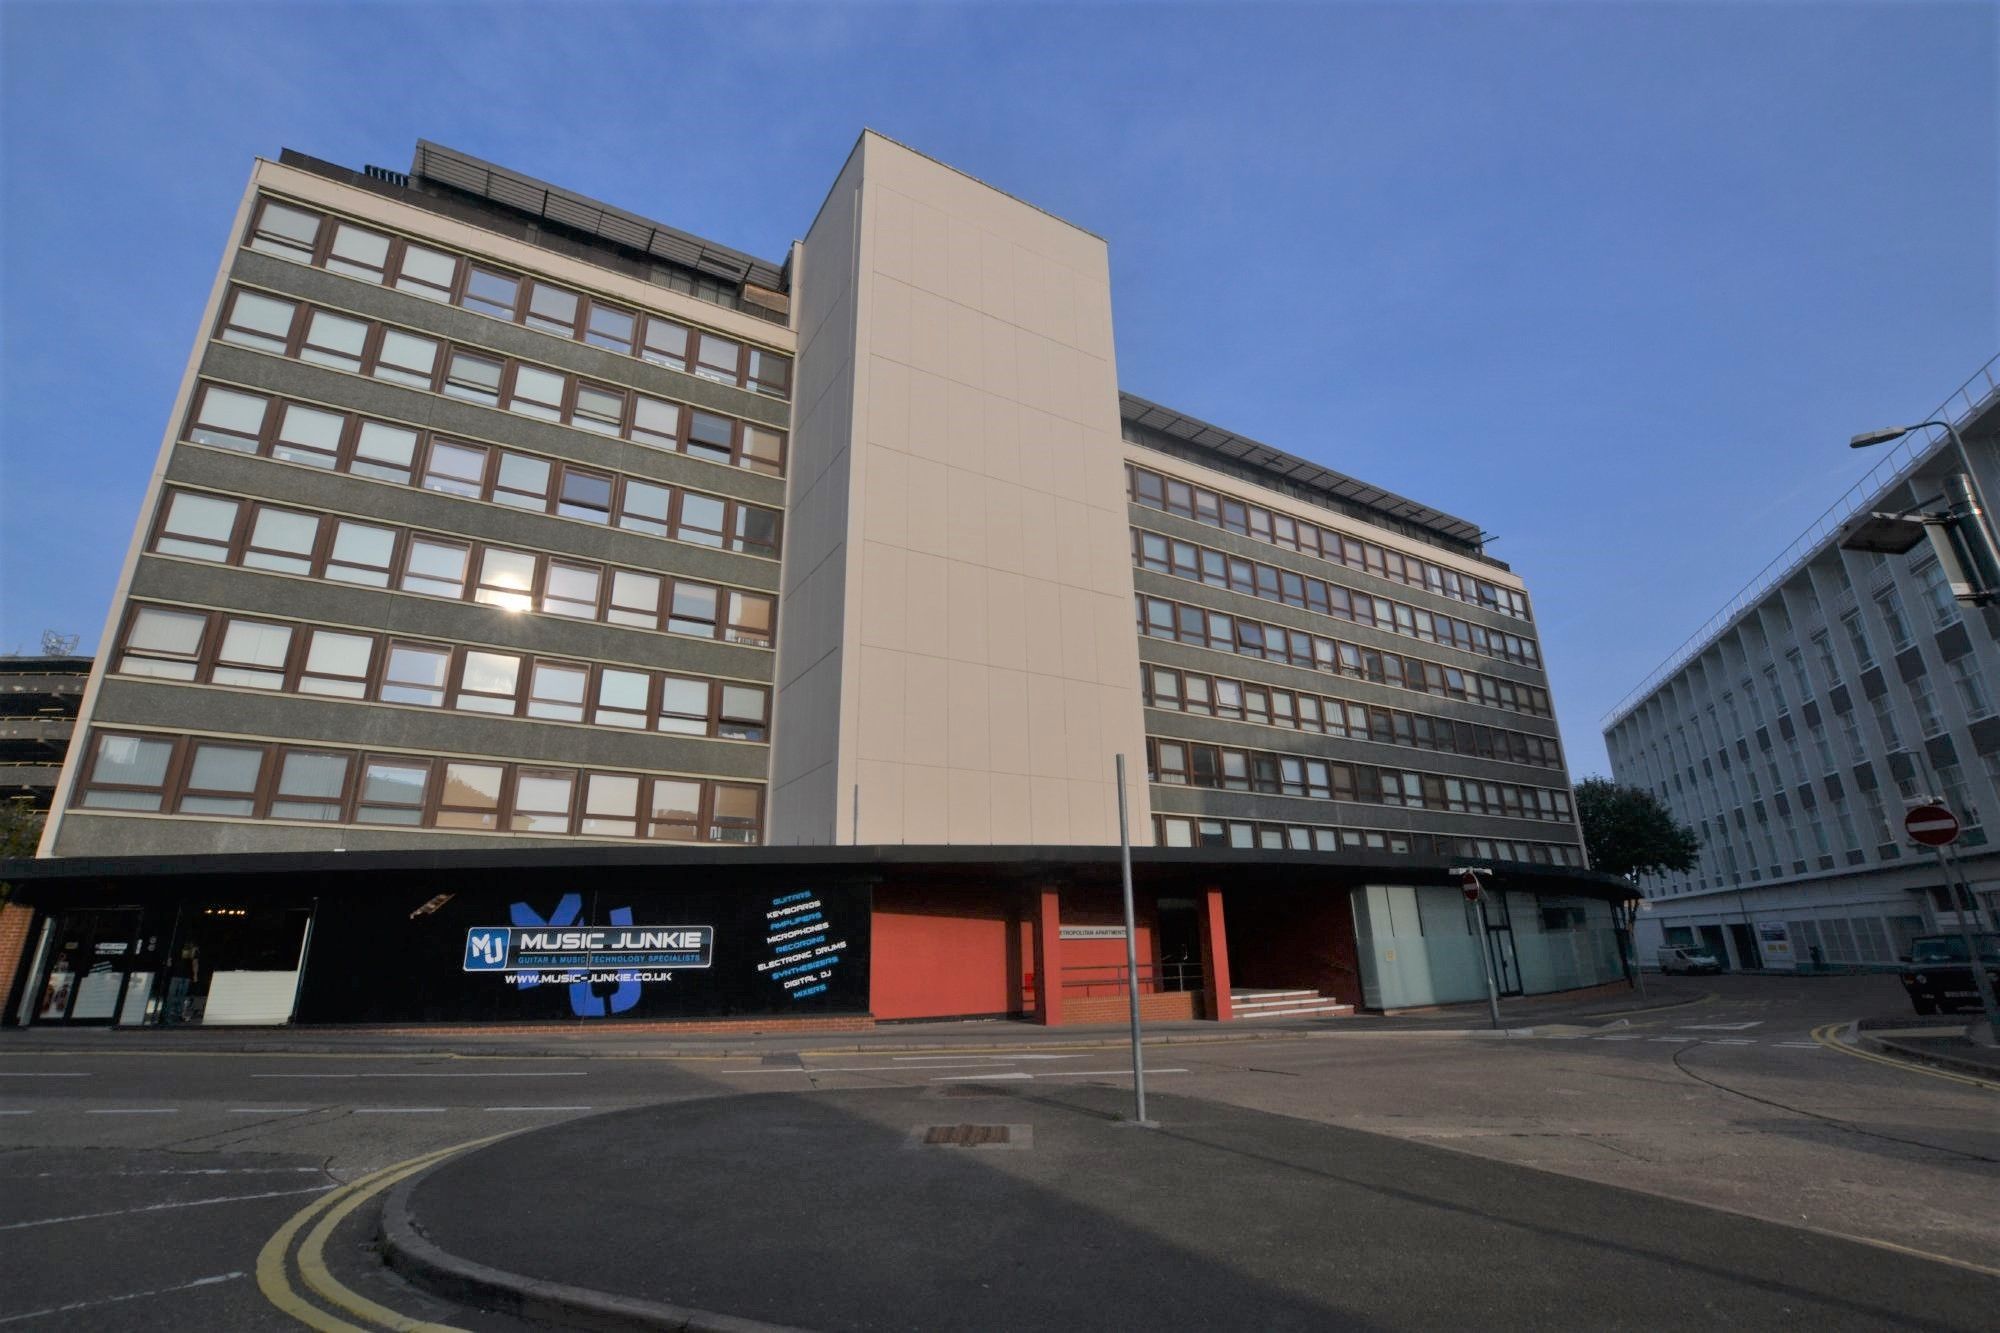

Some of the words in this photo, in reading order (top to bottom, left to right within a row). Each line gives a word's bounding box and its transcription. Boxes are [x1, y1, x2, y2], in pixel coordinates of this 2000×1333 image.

[773, 890, 812, 906] GUITARS
[766, 900, 822, 919] KEYBOARDS
[520, 933, 605, 950] MUSIC
[611, 932, 702, 949] JUNKIE
[766, 921, 830, 944] MICROPHONES
[1059, 929, 1094, 937] ETROPOLITAN
[775, 935, 825, 954] RECORDING
[518, 956, 549, 965] GUITAR
[560, 955, 587, 964] MUSIC
[590, 955, 646, 964] TECHNOLOGY
[647, 954, 701, 963] SPECIALISTS
[757, 950, 813, 972] ELECTRONIC
[814, 940, 847, 956] DRUMS
[505, 972, 673, 984] WWW.MUSIC-JUNKIE.CO.UK
[784, 974, 818, 989] DIGITAL
[820, 969, 832, 979] DJ
[793, 983, 829, 999] MIXERS
